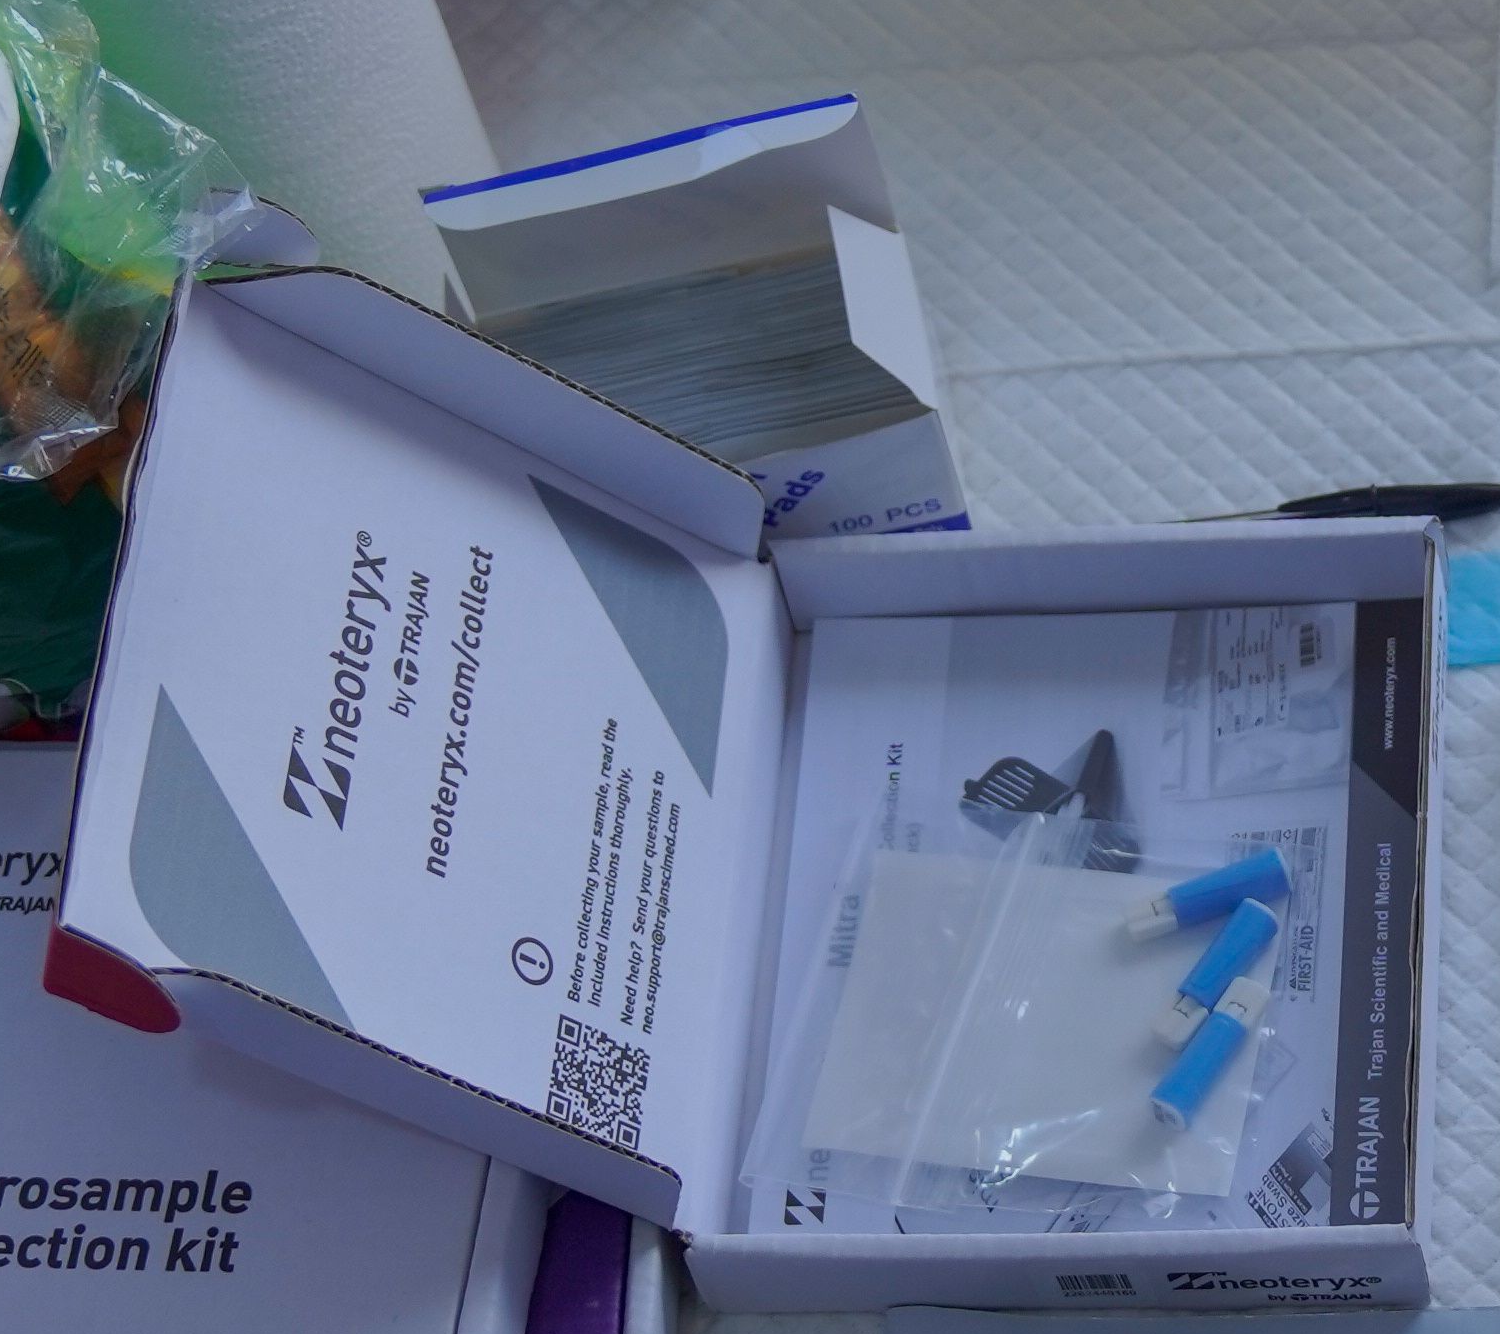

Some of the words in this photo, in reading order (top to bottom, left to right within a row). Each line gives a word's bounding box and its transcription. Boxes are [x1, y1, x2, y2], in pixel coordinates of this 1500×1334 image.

[827, 512, 874, 533] 100
[883, 495, 944, 524] PCS
[398, 568, 432, 657] TRAJAN
[386, 685, 418, 719] by
[424, 543, 495, 880] neoteryx.com/collect
[1383, 635, 1398, 750] www.neoteryx.com
[602, 717, 618, 742] the
[600, 741, 615, 779] read
[651, 769, 665, 786] to
[592, 781, 612, 838] sample,
[607, 765, 635, 850] thoroughly.
[644, 787, 663, 859] questions
[586, 837, 602, 876] your
[639, 858, 653, 896] your
[1373, 841, 1392, 905] Medical
[574, 874, 601, 951] collecting
[631, 894, 649, 935] Send
[640, 800, 682, 1036] neo.support@trajanscimed.com
[825, 892, 862, 970] Mitra
[1373, 909, 1390, 941] and
[566, 950, 586, 1003] Before
[624, 939, 645, 985] help?
[1292, 923, 1315, 992] FIRST-AID
[1368, 944, 1388, 1023] Scientific
[619, 983, 638, 1026] Need
[1366, 1027, 1388, 1080] Trajan
[1353, 1094, 1384, 1190] TRAJAN
[163, 1224, 241, 1274] kit
